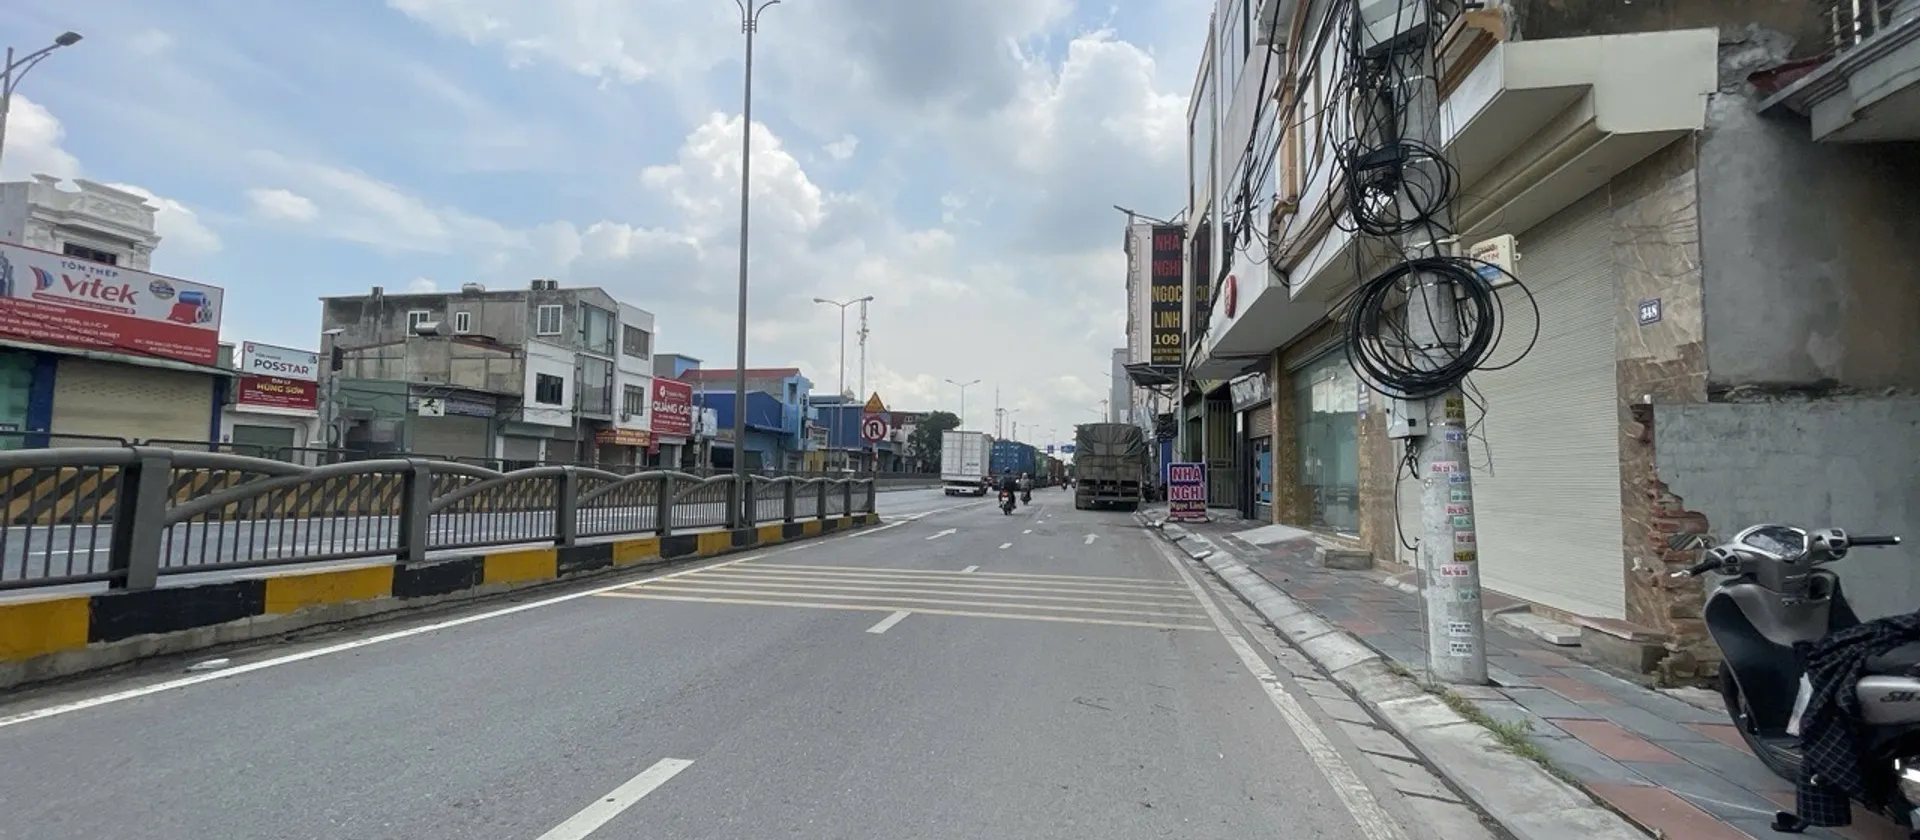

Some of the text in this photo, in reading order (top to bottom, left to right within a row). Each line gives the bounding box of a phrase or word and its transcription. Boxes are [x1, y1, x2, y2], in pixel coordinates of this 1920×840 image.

[1155, 232, 1180, 251] NHÀ
[61, 260, 86, 272] TÔN
[1152, 285, 1182, 306] NGỌC
[1153, 311, 1180, 329] LINH
[1154, 334, 1180, 345] 109
[254, 358, 309, 375] POSSTAR
[1172, 465, 1203, 482] NHÀ
[1170, 484, 1205, 501] NGHỈ
